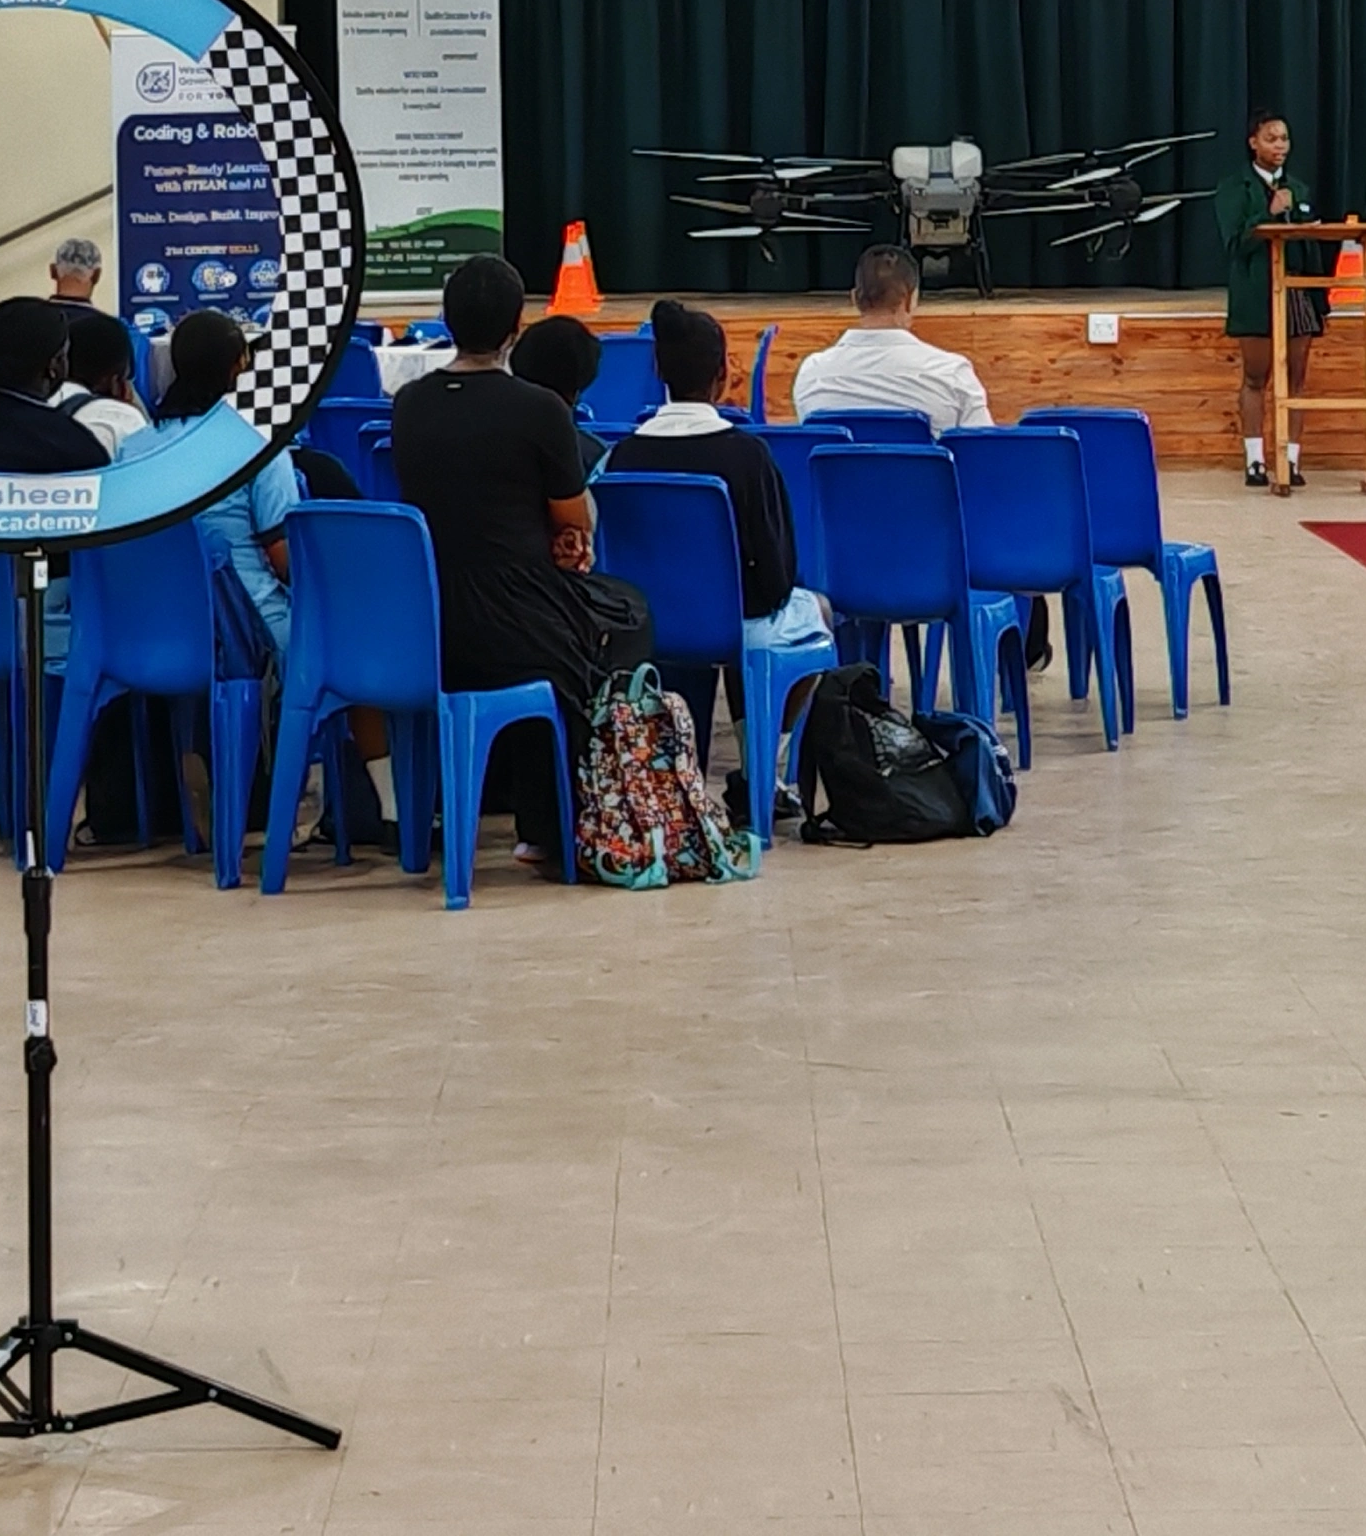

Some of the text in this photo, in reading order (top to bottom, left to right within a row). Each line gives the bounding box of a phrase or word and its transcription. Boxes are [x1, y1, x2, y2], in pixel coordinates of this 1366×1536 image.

[133, 121, 257, 145] Coding & Robo
[143, 162, 271, 178] Future-Ready Learnin
[155, 180, 182, 193] with
[229, 178, 251, 191] and
